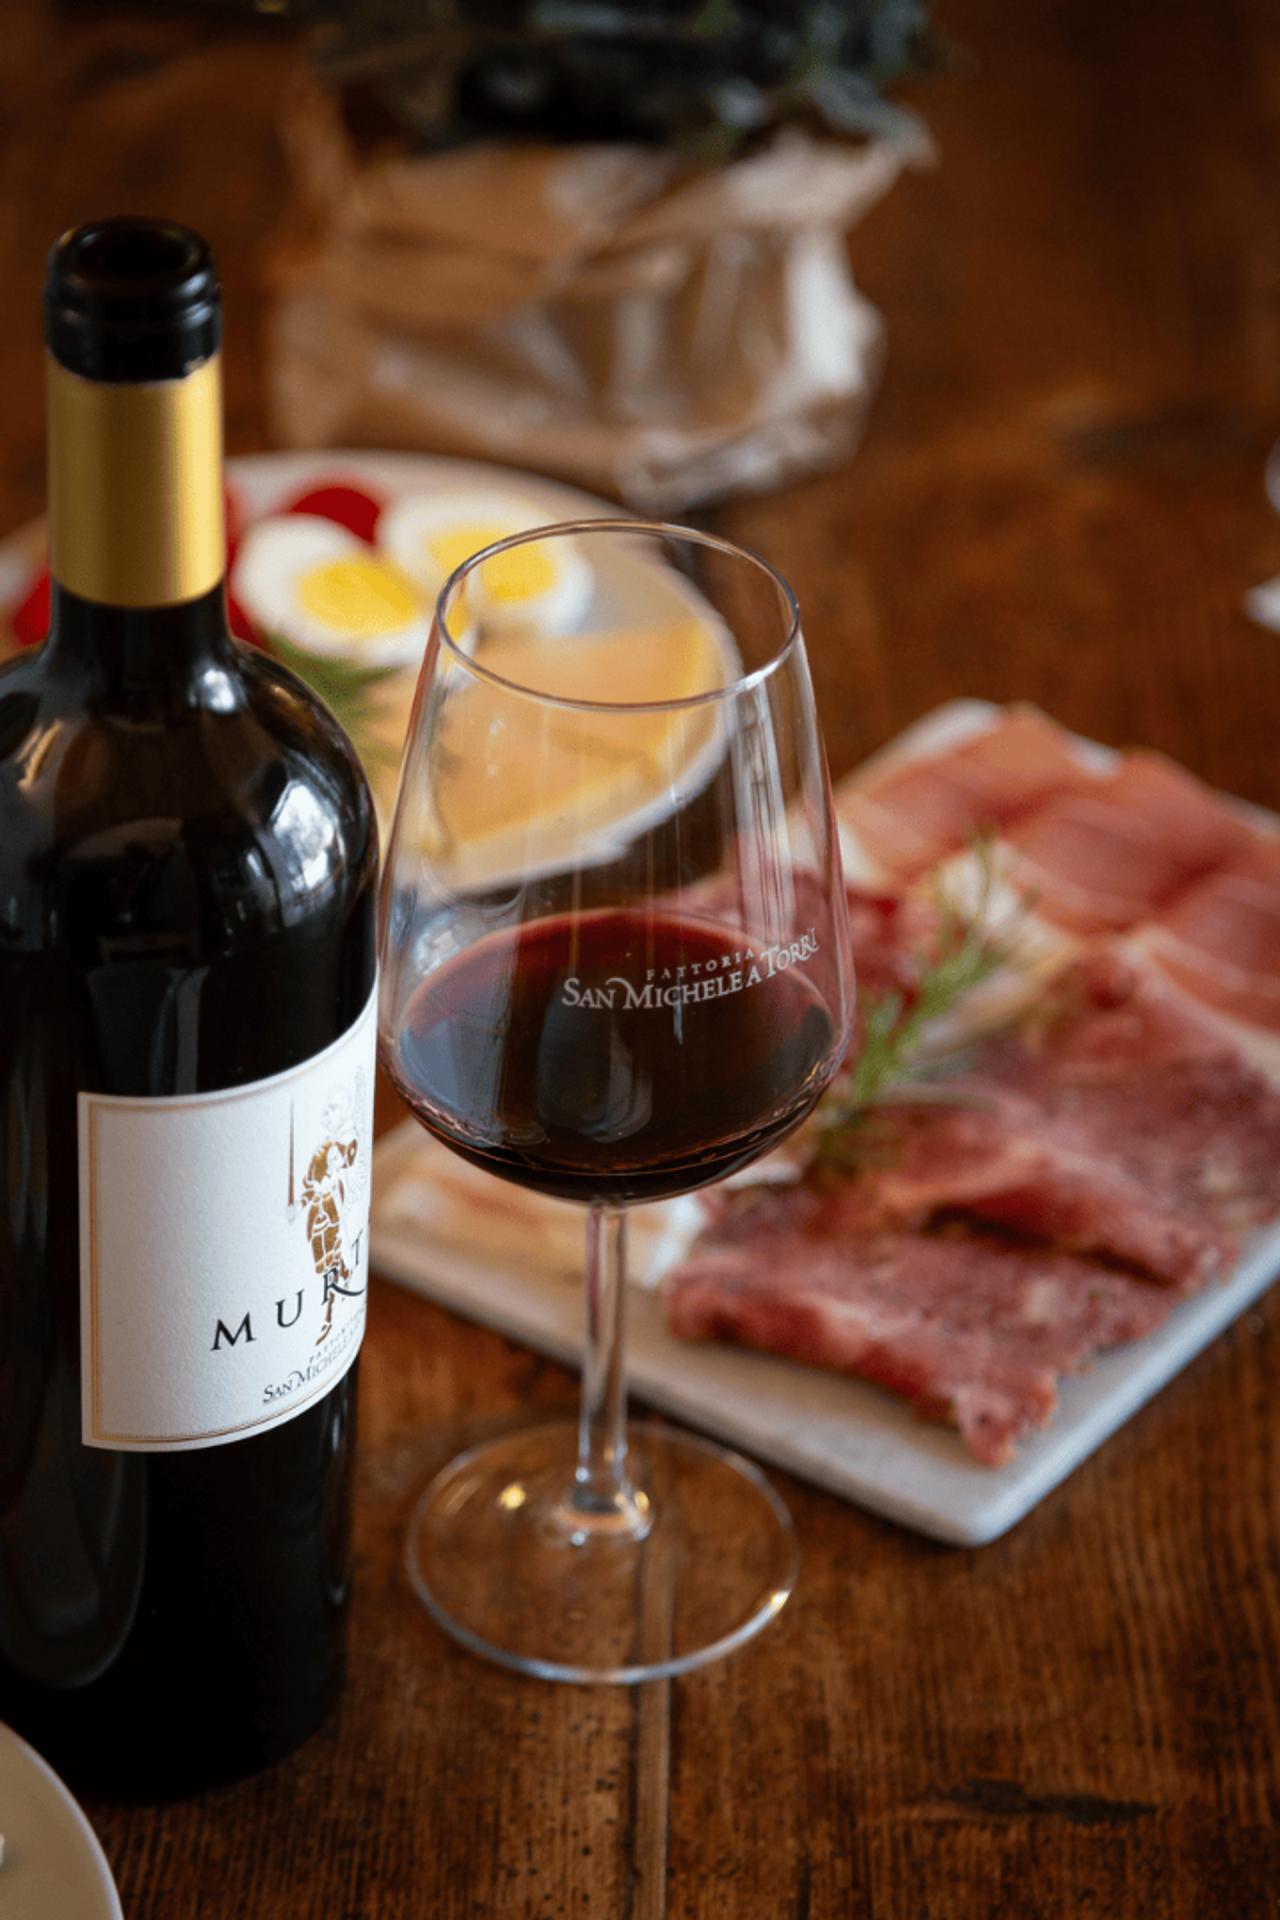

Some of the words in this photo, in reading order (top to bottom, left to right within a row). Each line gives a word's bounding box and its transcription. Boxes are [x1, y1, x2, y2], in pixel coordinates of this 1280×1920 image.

[561, 977, 616, 1009] SAN
[605, 971, 743, 1009] MICHELE
[745, 964, 762, 988] A
[759, 927, 820, 978] TORRI
[646, 948, 755, 981] FATTORIA
